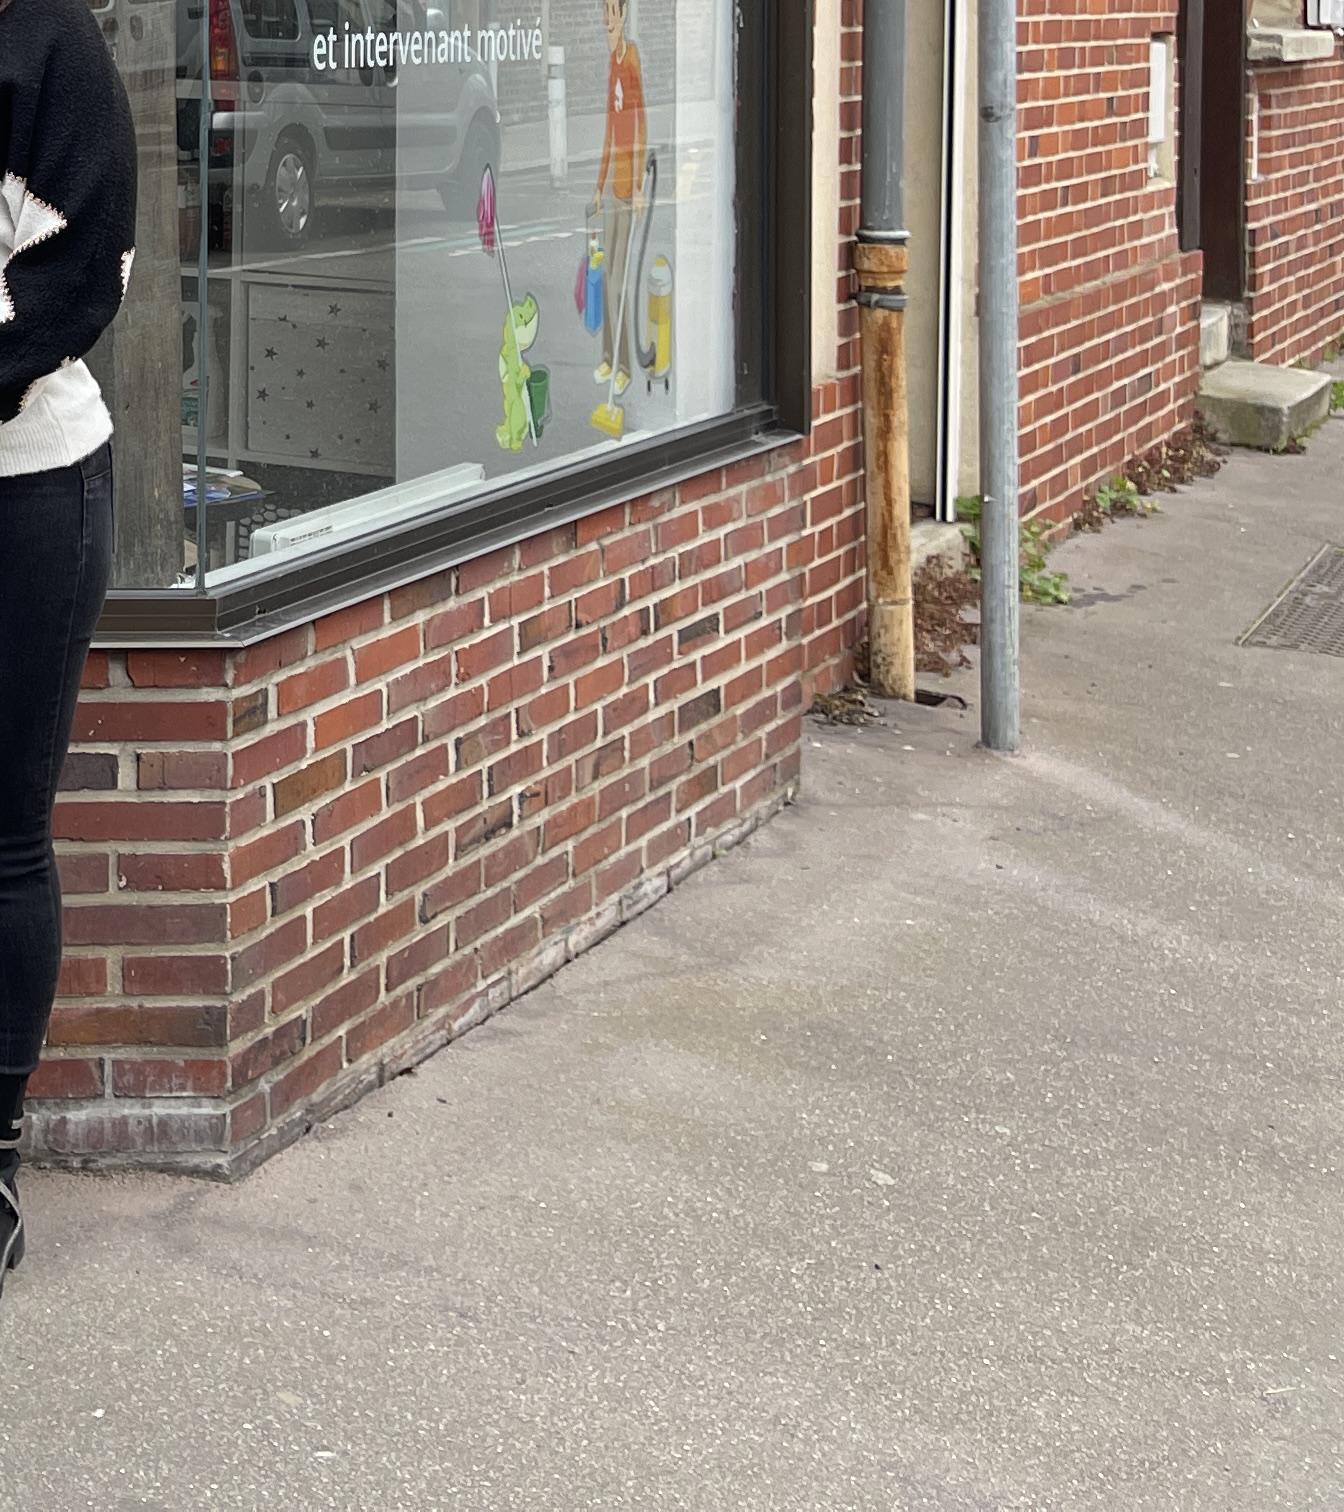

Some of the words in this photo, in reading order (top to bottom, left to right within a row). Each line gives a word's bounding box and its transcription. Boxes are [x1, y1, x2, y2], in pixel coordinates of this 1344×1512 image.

[313, 26, 337, 71] et
[344, 21, 471, 69] intervenant
[477, 16, 543, 61] motivé
